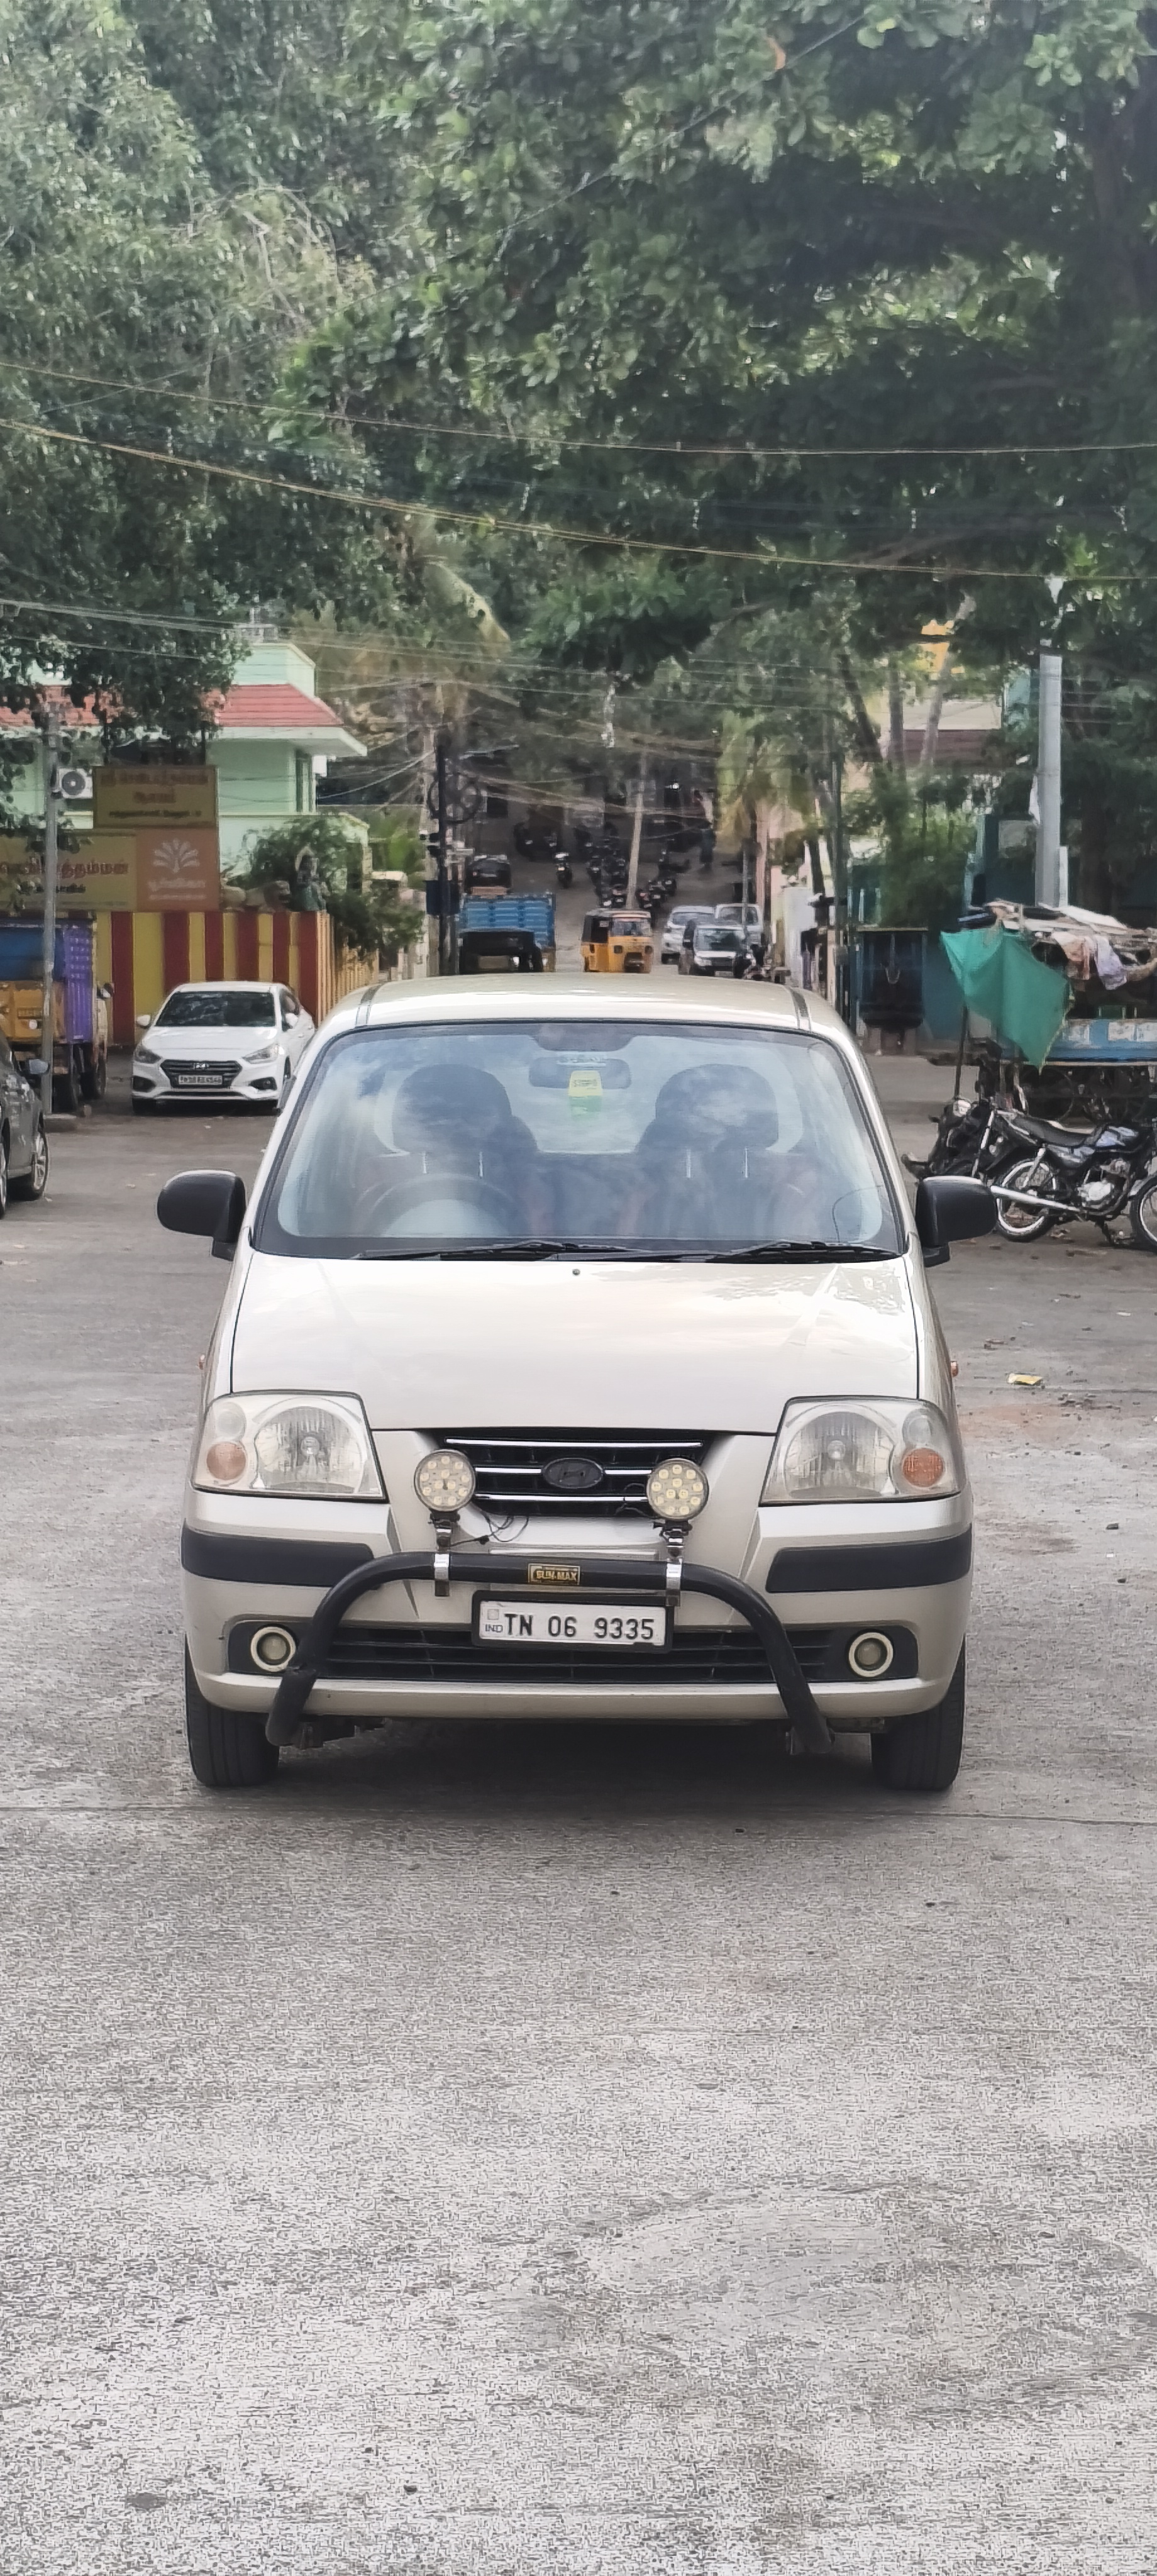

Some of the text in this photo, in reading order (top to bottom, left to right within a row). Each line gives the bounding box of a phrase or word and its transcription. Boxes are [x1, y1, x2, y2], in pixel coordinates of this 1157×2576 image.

[485, 1624, 502, 1633] IND
[504, 1613, 655, 1640] TN 06 9335
